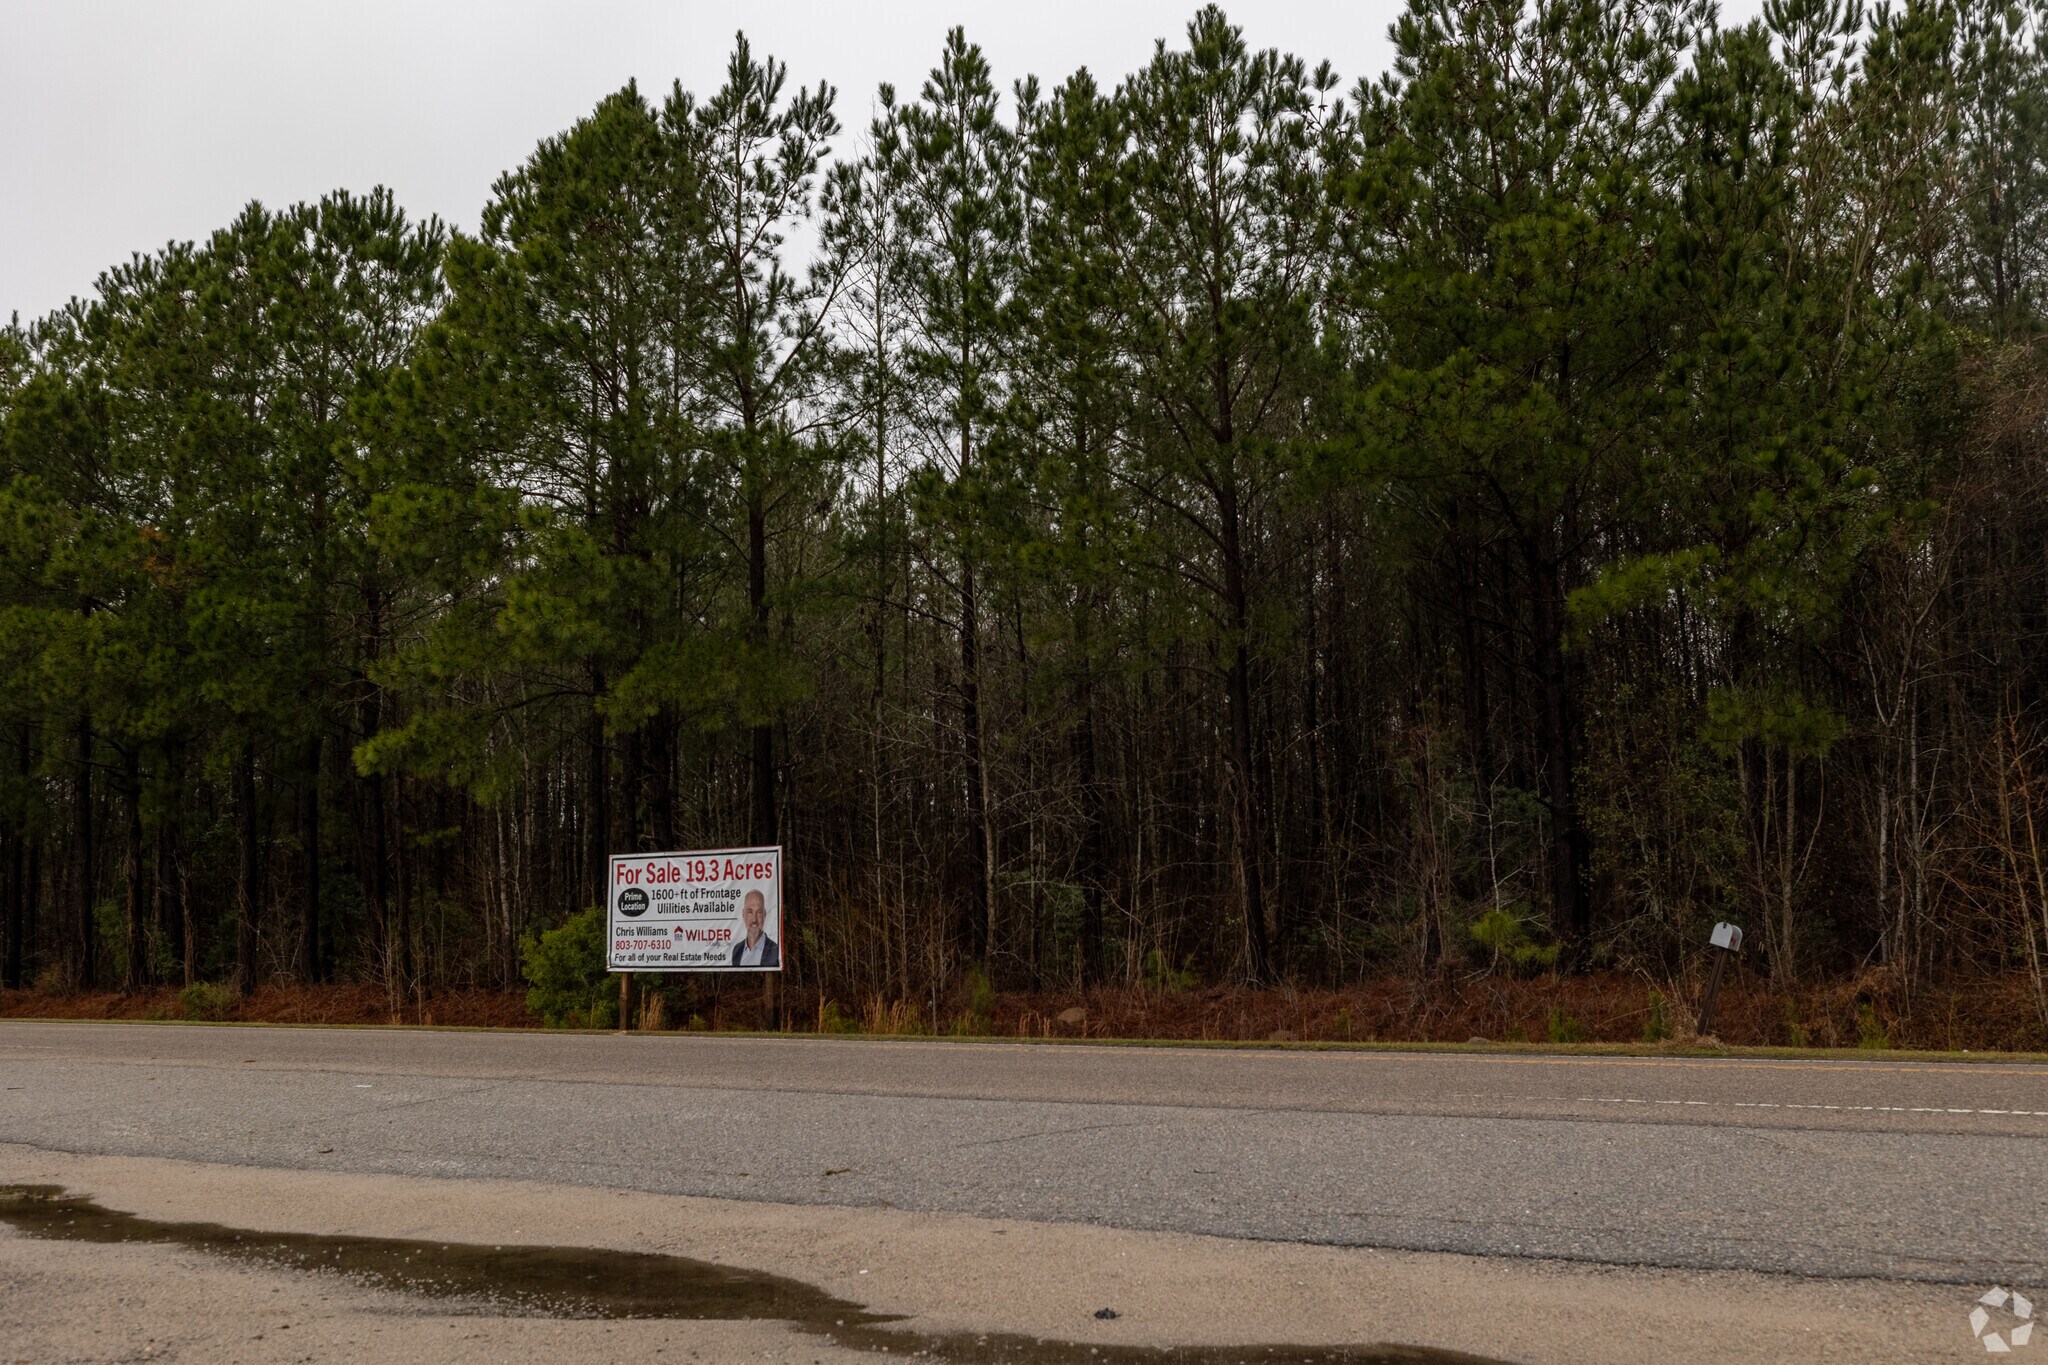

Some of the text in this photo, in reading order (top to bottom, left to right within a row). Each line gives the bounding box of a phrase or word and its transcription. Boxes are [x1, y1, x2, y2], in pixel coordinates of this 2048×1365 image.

[616, 859, 772, 885] For Sale 19.3 Acres
[624, 892, 642, 901] Prime
[690, 889, 699, 899] of
[701, 888, 741, 899] Frontage
[620, 902, 645, 911] Location
[692, 901, 734, 913] Available
[615, 926, 668, 936] Chris Williams
[685, 929, 731, 941] WILDER
[615, 939, 671, 950] 803-707-6310
[628, 953, 636, 961] all
[638, 953, 645, 961] of
[646, 955, 660, 963] your
[663, 953, 679, 961] Real
[680, 953, 702, 961] Estate
[704, 953, 726, 961] Needs
